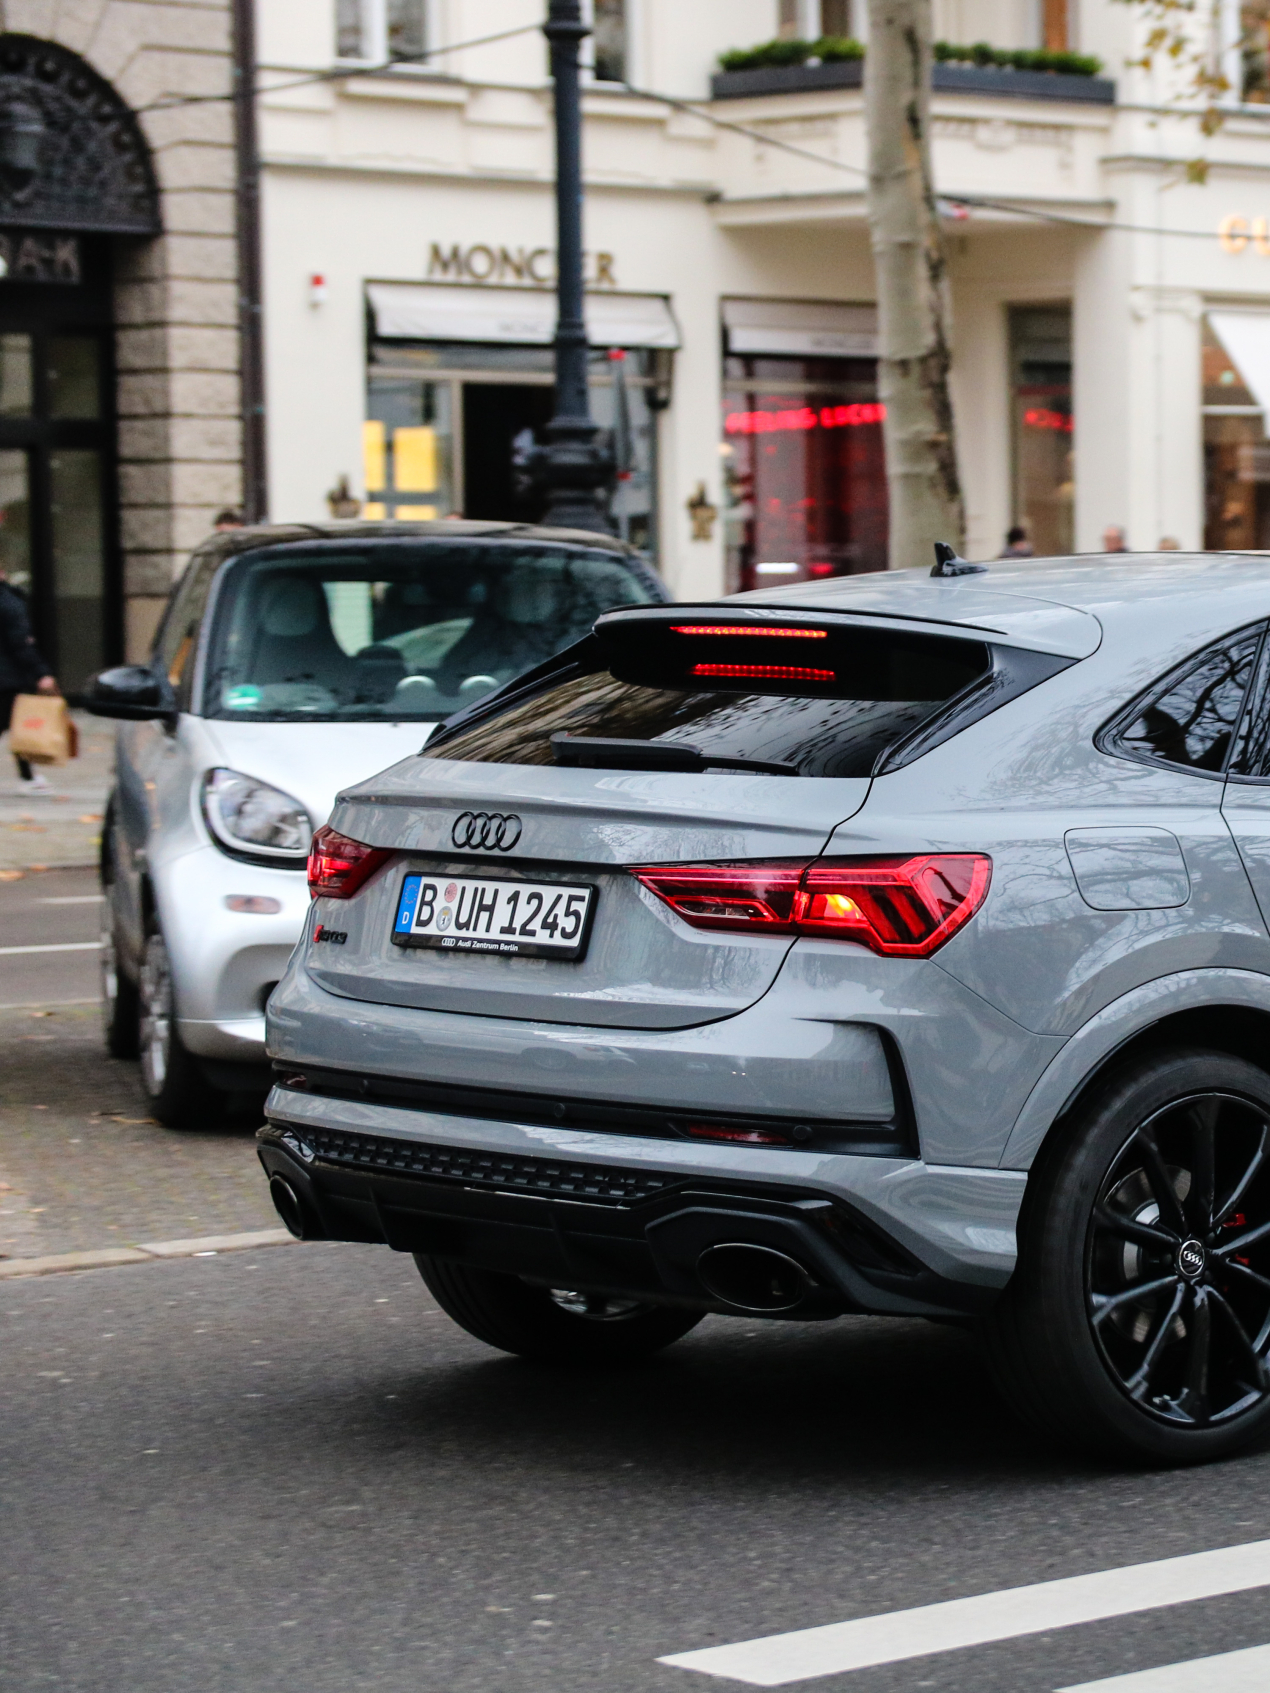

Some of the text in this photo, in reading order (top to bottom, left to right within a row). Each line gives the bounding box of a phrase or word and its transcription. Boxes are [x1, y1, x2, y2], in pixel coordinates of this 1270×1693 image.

[428, 241, 616, 287] MONCR
[415, 883, 438, 927] B
[457, 939, 519, 952] Audi Zentrum Berlin
